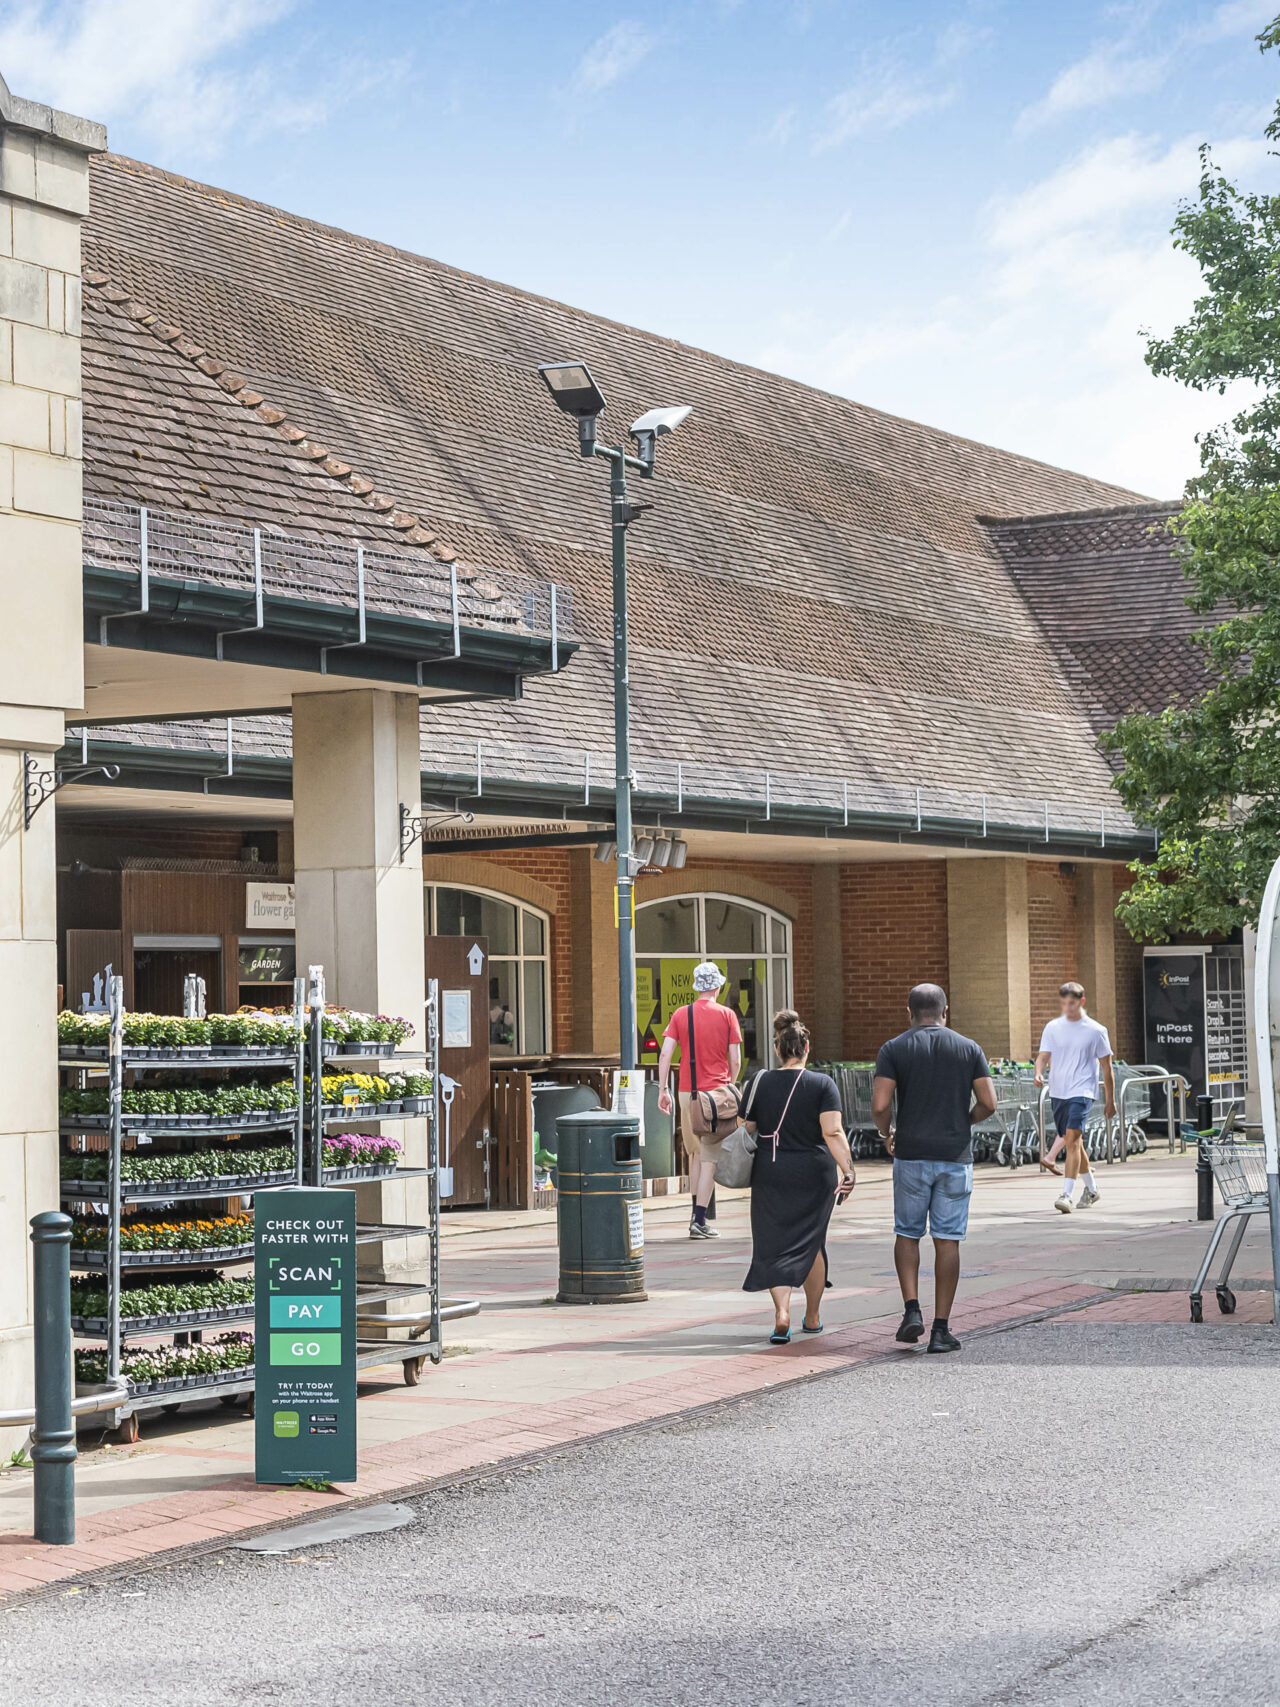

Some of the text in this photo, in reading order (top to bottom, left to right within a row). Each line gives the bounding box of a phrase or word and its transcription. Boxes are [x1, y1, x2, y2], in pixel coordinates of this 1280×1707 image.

[253, 900, 296, 921] flower ga
[252, 959, 281, 969] GARDEN
[671, 974, 691, 988] NEW
[667, 992, 695, 1006] LOWER
[1156, 1023, 1193, 1032] InPost
[1157, 1034, 1193, 1044] it here
[266, 1220, 344, 1230] CHECK OUT
[261, 1233, 349, 1244] FASTER WITH
[278, 1266, 332, 1281] SCAN
[288, 1304, 324, 1319] PAY
[291, 1342, 321, 1357] GO
